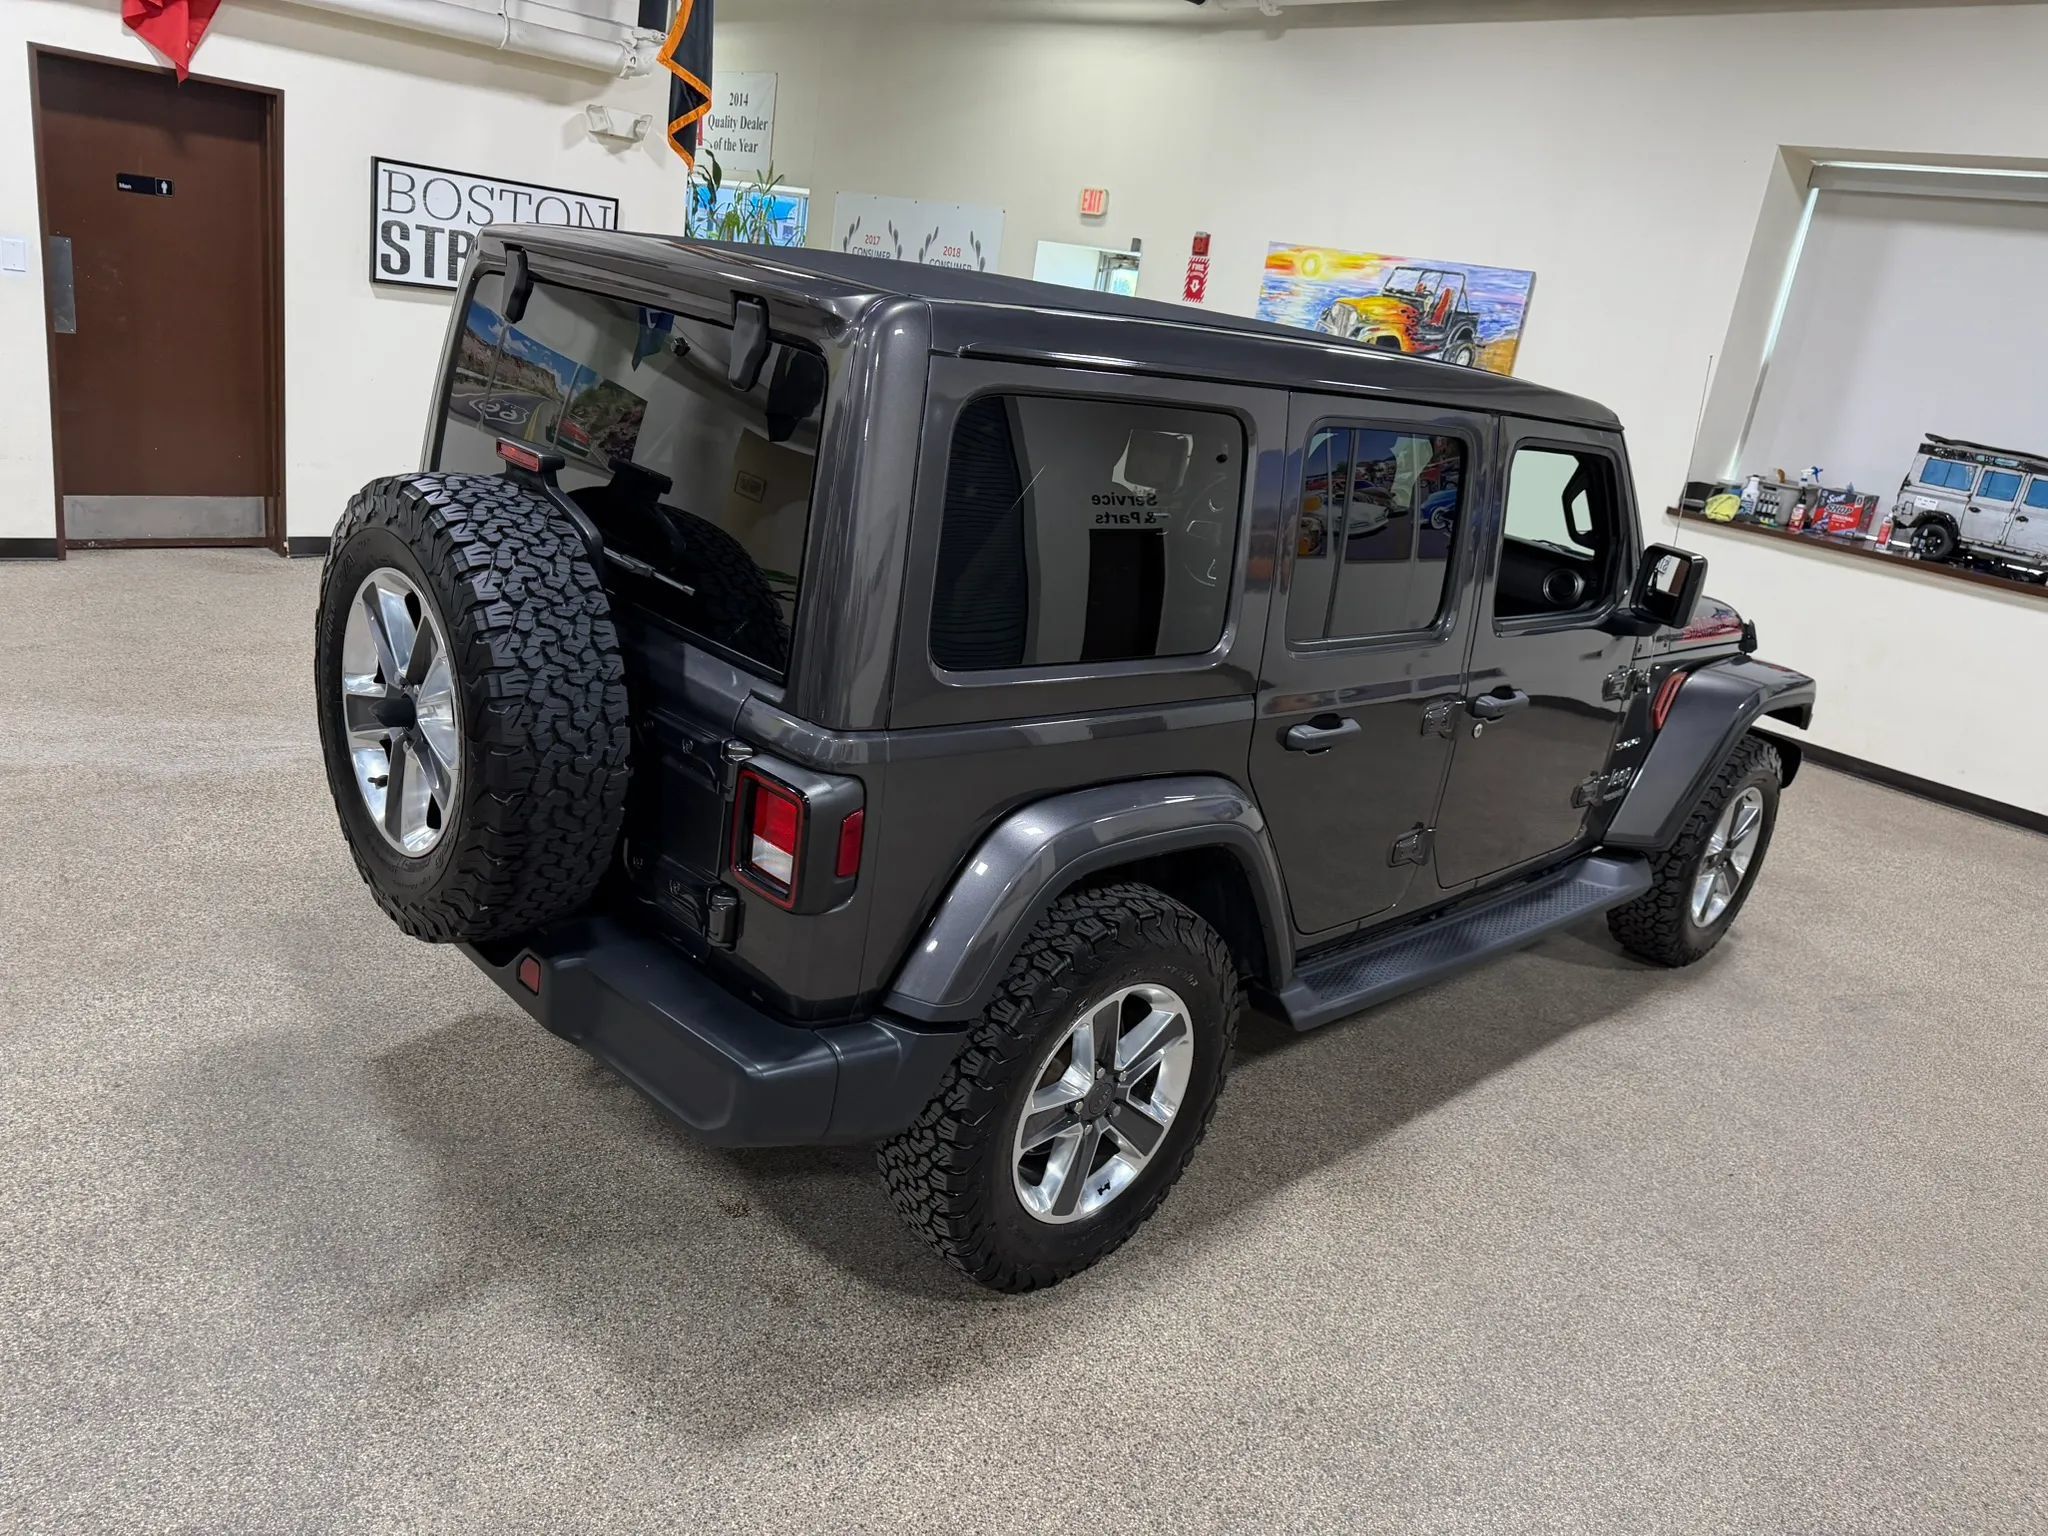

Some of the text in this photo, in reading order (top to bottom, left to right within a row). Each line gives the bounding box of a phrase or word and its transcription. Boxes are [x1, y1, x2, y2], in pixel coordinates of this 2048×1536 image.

[729, 92, 749, 106] 2014
[708, 114, 768, 132] Quality Dealer
[713, 137, 759, 153] of the Year
[382, 169, 611, 227] BOSTON
[1081, 189, 1104, 213] EXIT
[864, 234, 881, 246] 2017
[943, 246, 961, 258] 2018
